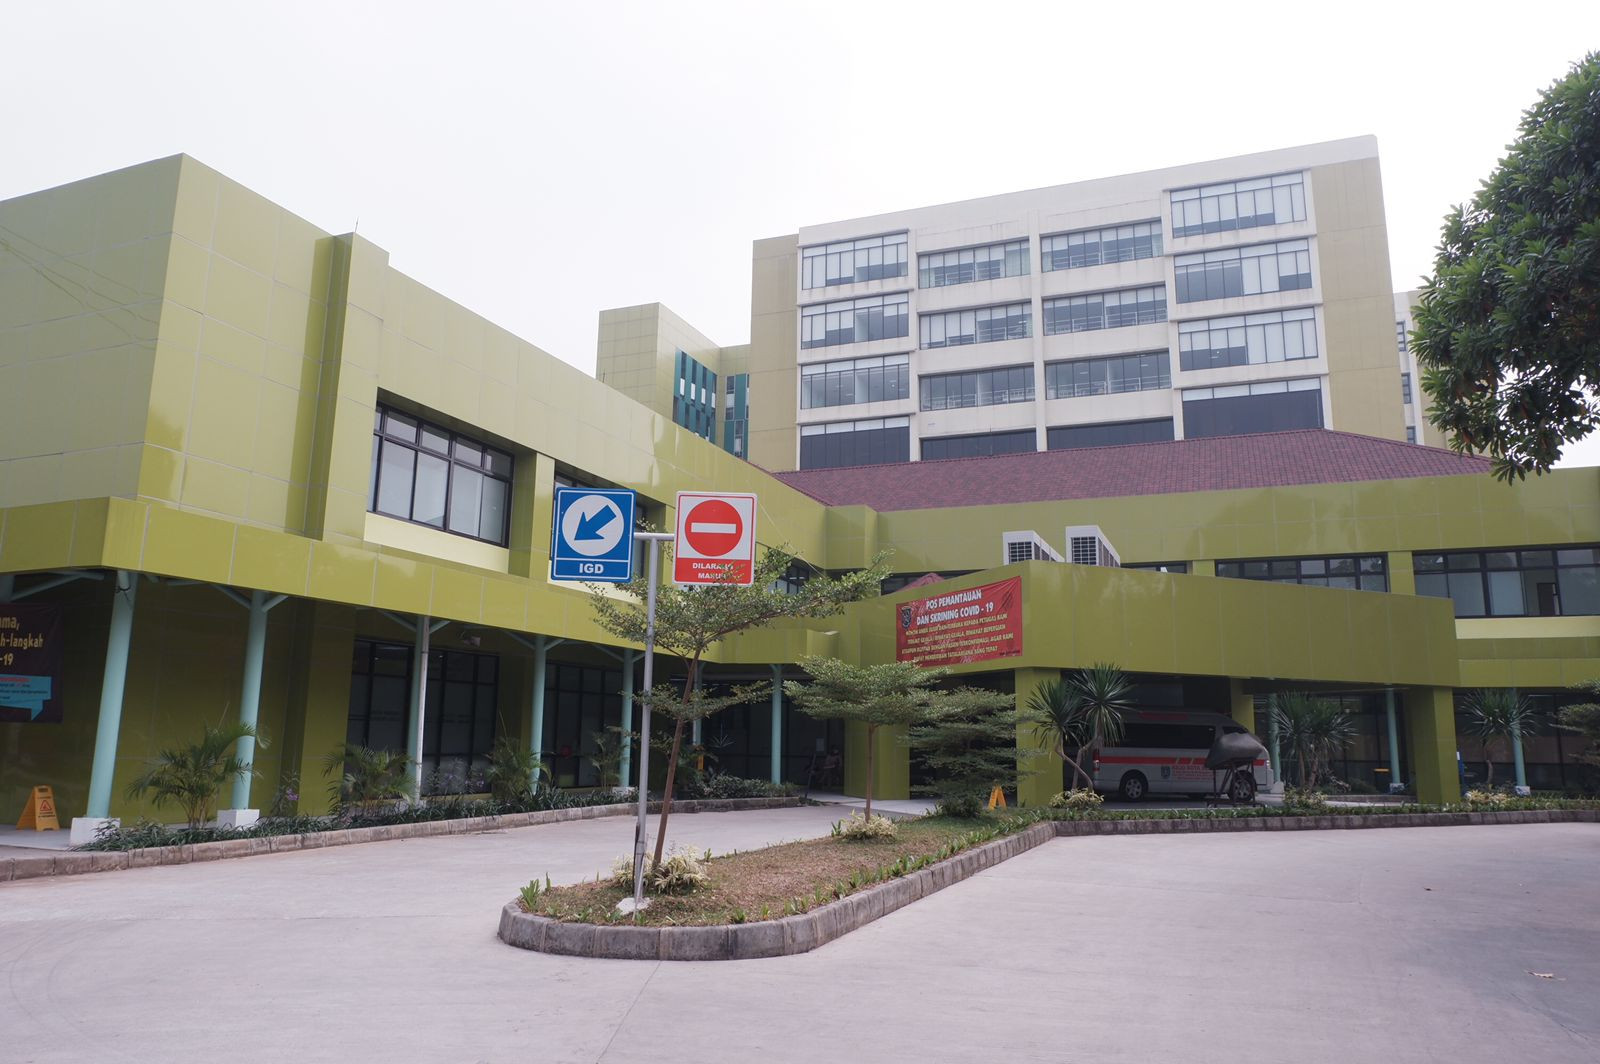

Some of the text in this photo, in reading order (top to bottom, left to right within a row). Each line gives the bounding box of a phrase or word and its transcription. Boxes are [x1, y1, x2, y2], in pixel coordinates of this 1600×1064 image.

[579, 563, 604, 574] IGD
[926, 589, 982, 610] POS PEMANTAUAN
[917, 614, 929, 626] DAN
[930, 609, 959, 623] SKRINING
[960, 605, 980, 617] COVID
[985, 602, 994, 612] 19
